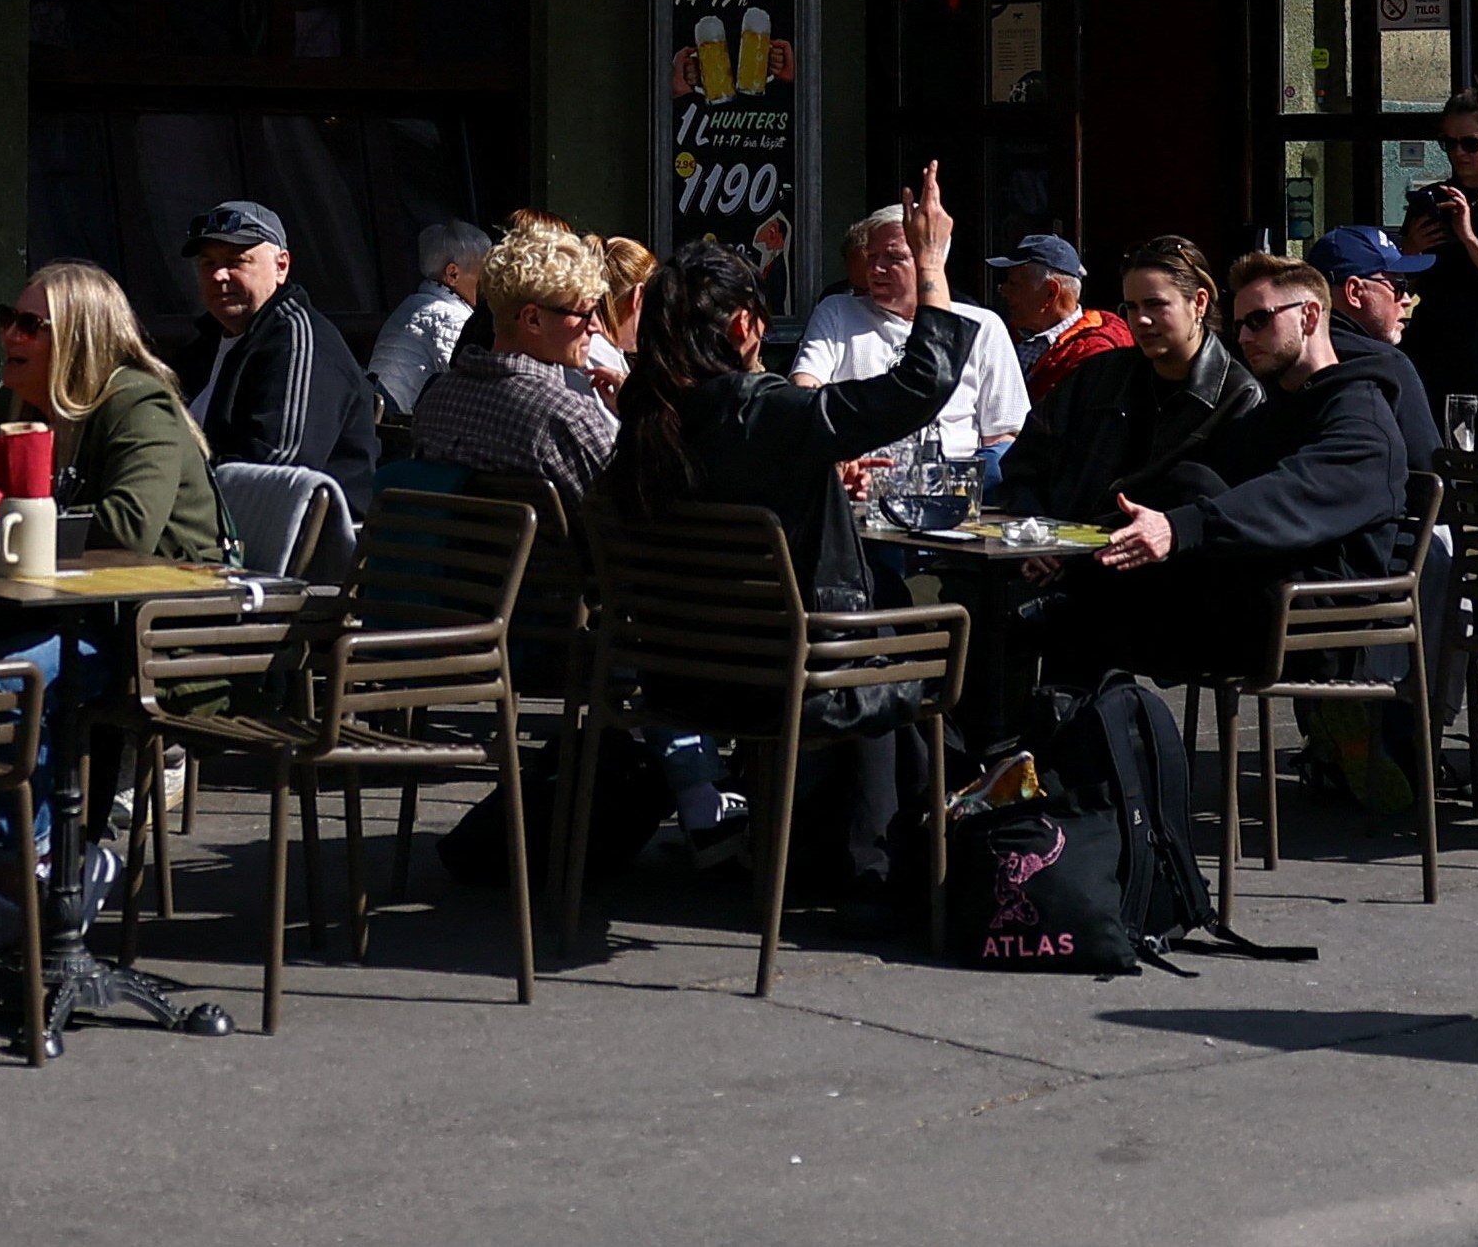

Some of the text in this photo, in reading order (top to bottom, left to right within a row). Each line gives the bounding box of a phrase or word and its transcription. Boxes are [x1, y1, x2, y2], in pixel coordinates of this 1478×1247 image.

[1415, 5, 1440, 15] TILOS
[710, 110, 789, 131] HUNTER'S
[713, 134, 741, 147] 14-17
[983, 932, 1075, 958] ATLAS
